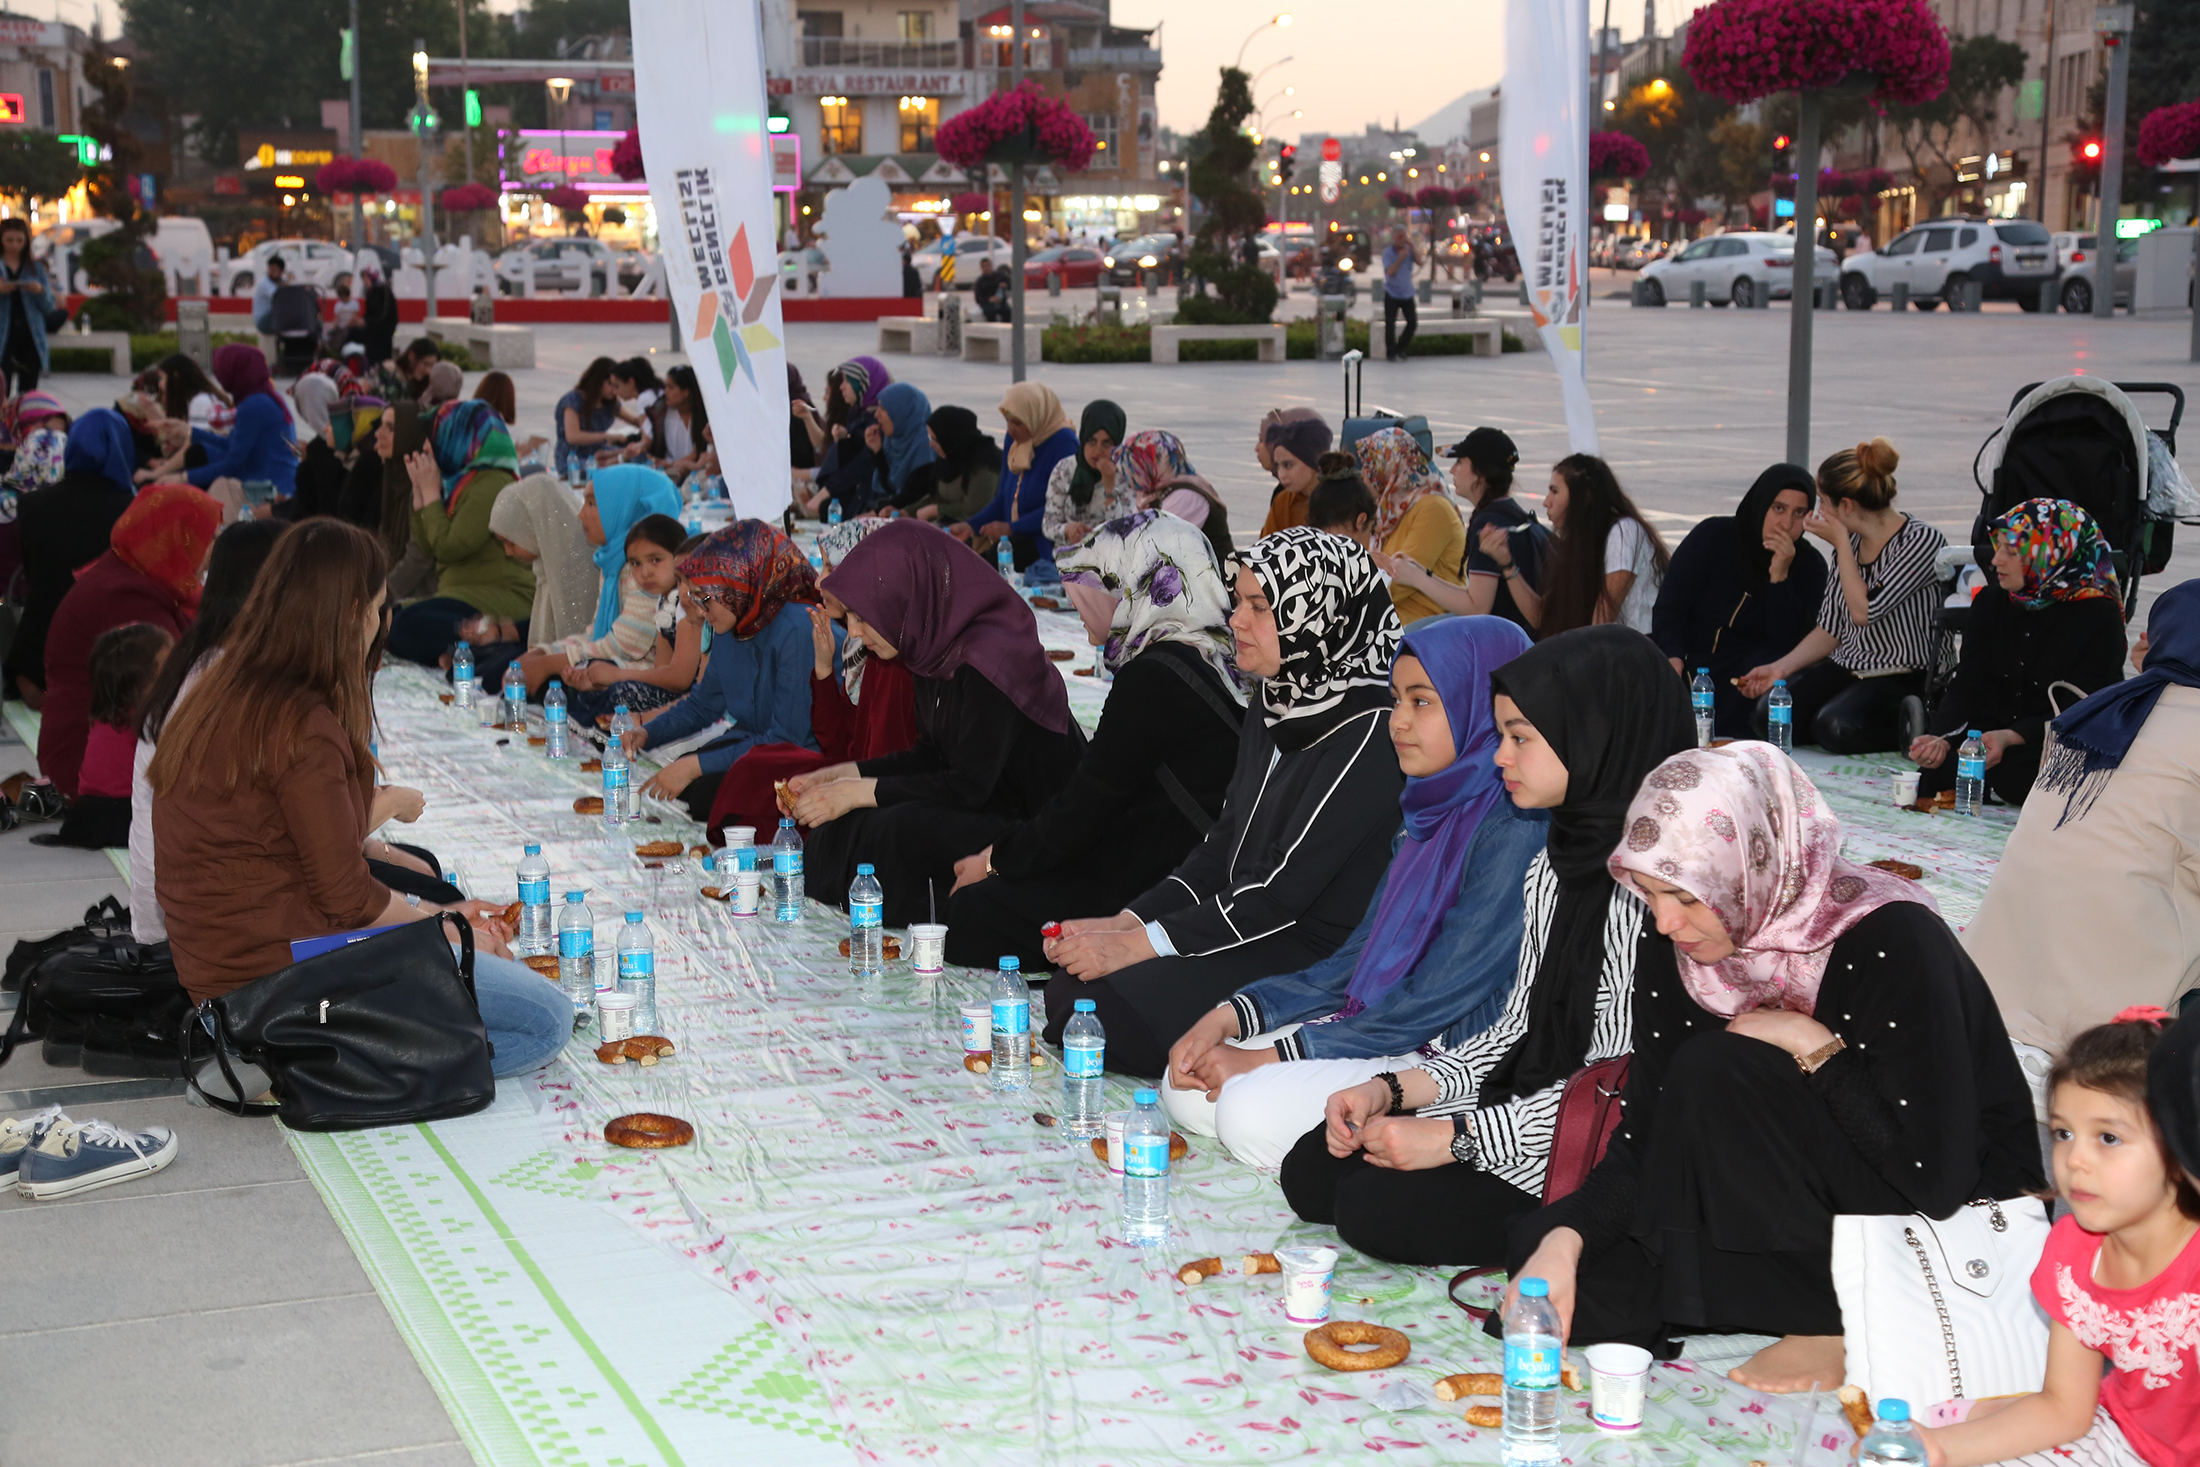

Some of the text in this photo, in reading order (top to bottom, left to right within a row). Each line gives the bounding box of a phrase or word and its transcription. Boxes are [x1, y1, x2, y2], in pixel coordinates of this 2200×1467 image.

[796, 75, 840, 92] DEVA
[844, 75, 951, 92] RESTAURANT
[858, 910, 878, 921] beysu
[1517, 1356, 1551, 1375] beysu
